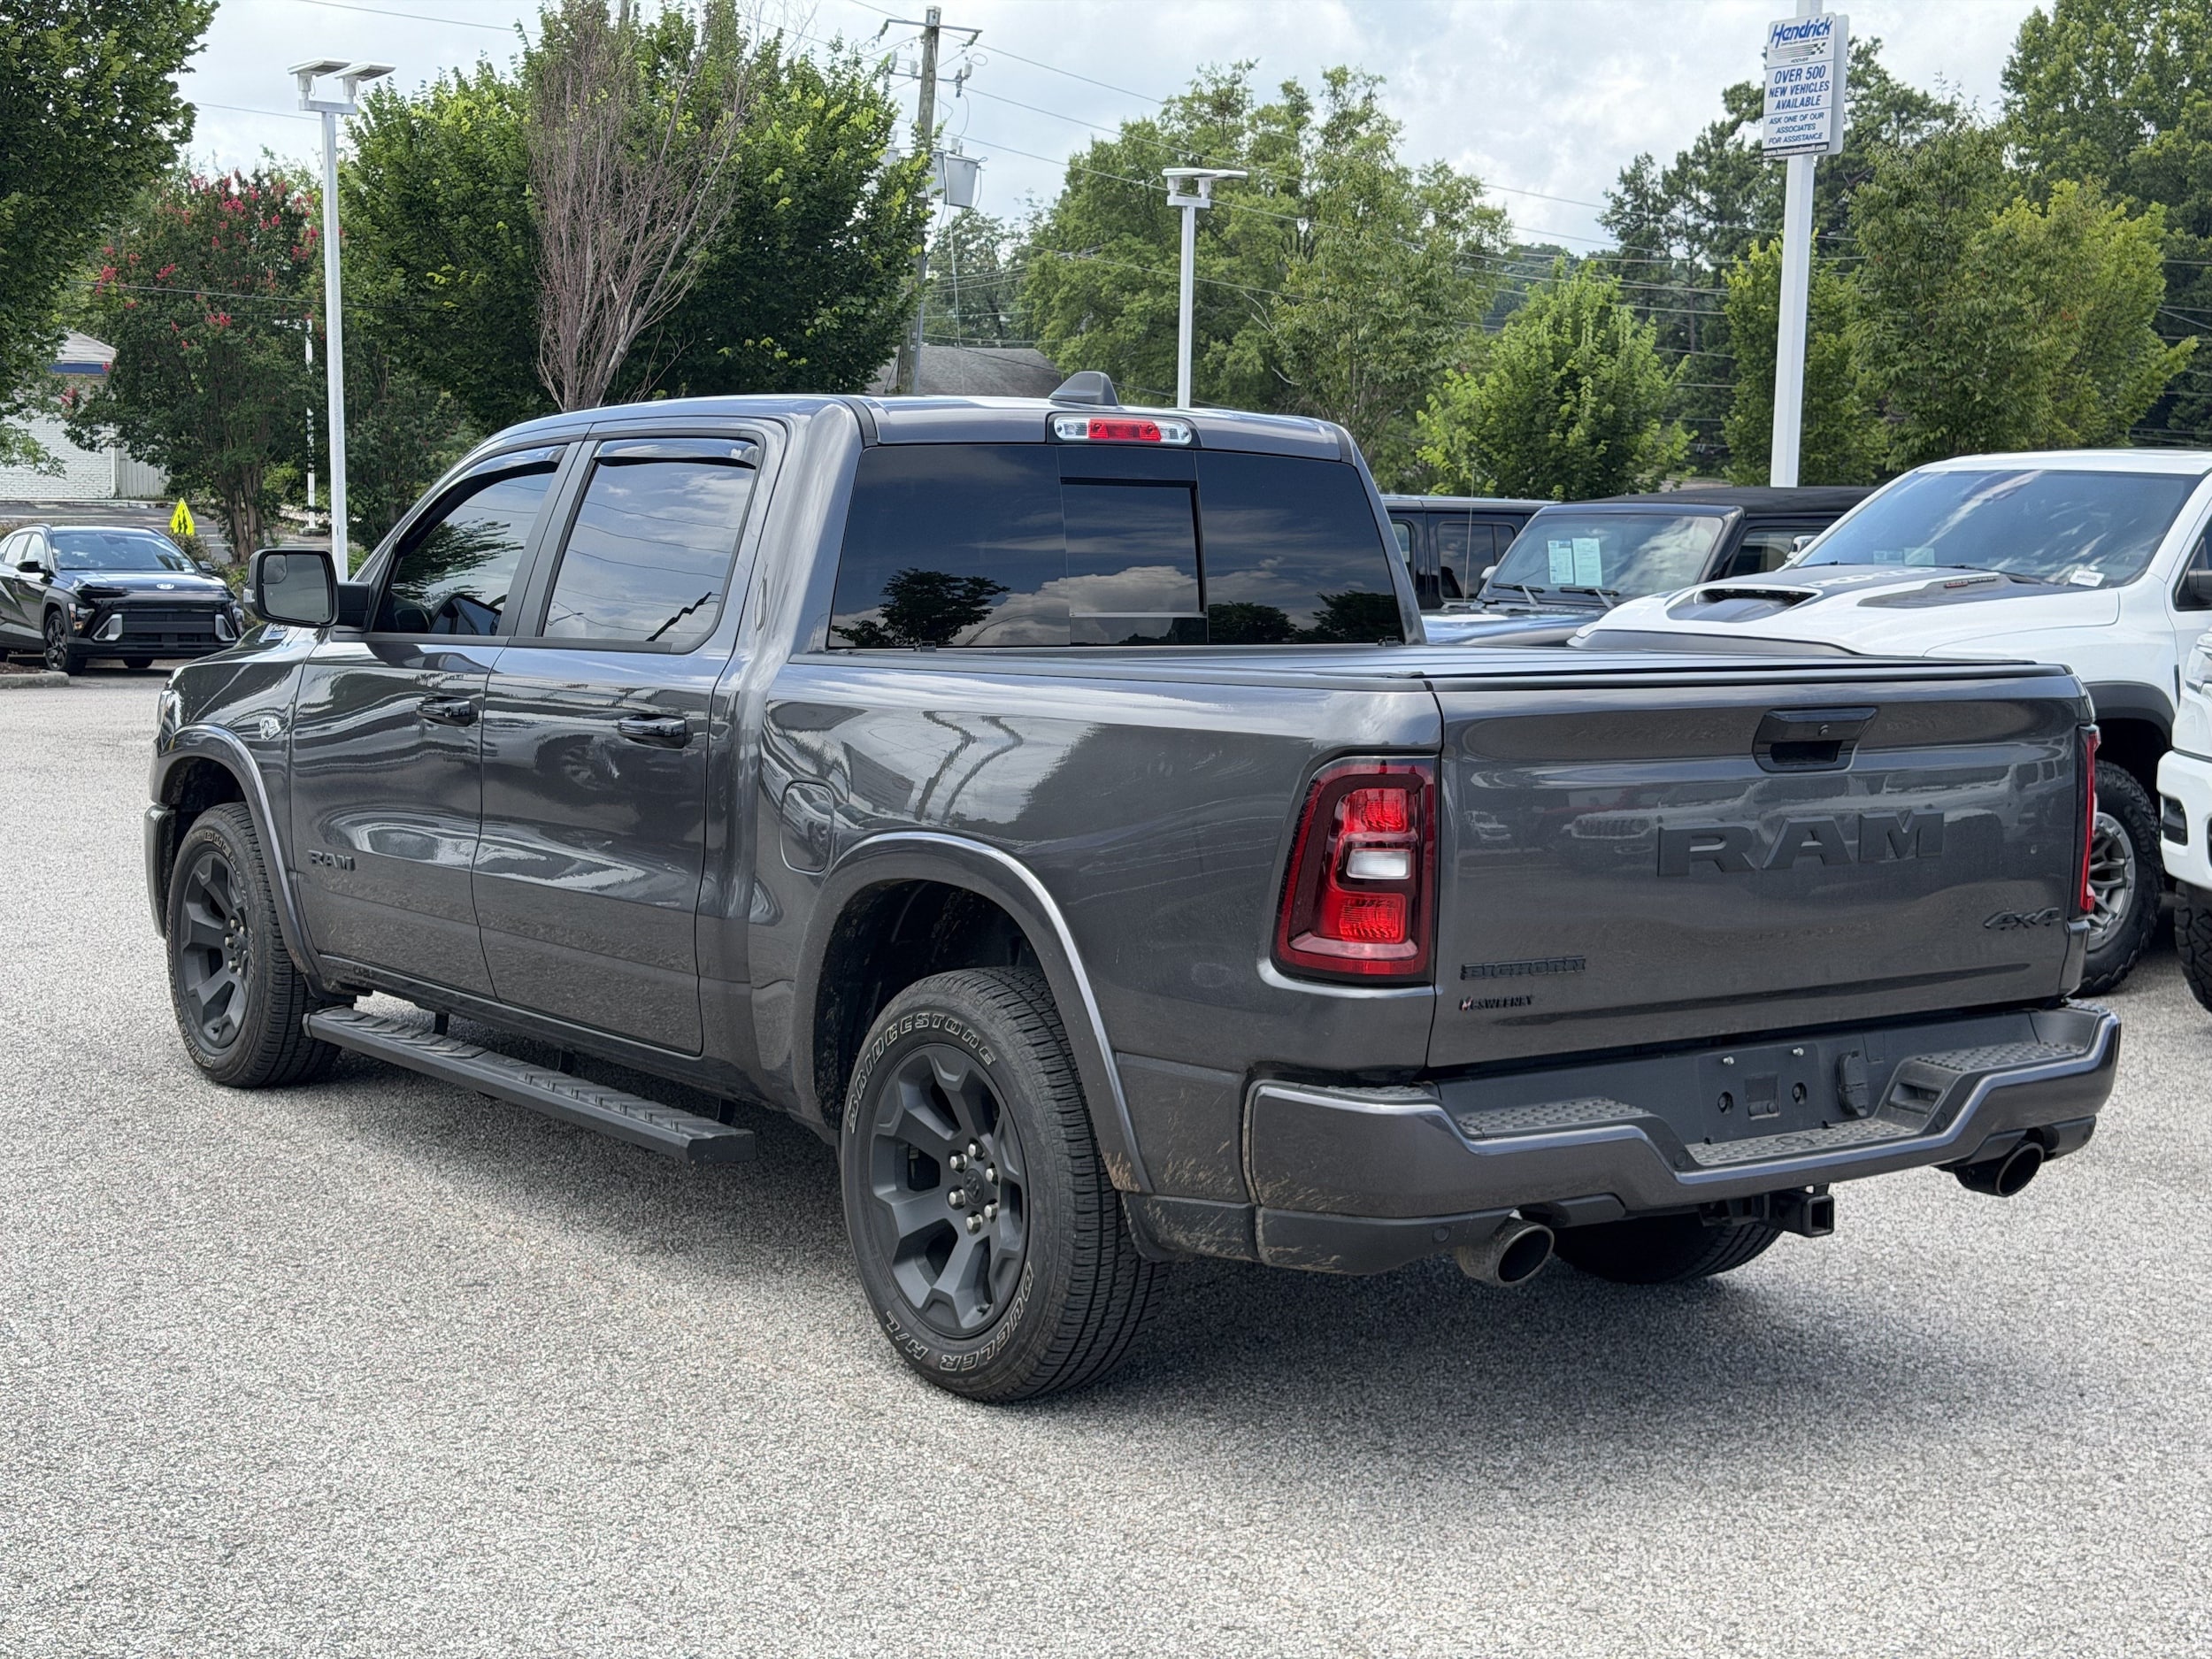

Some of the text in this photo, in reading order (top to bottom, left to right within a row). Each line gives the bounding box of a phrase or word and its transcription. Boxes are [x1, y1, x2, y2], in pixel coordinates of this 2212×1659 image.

[1770, 16, 1833, 49] Hendrick
[1774, 65, 1826, 84] OVER 500
[1769, 81, 1830, 98] NEW VEHICLES
[1775, 95, 1822, 111] AVAILABLE
[1769, 116, 1782, 125] ASK
[1809, 111, 1824, 120] OUR
[1776, 123, 1816, 134] ASSOCIATES
[1783, 132, 1824, 143] ASSISTANCE
[1657, 809, 1946, 877] RAM
[308, 849, 356, 872] RAM
[846, 1012, 996, 1134] BRIDGESTONE
[886, 1260, 1035, 1372] DUELER H/L
